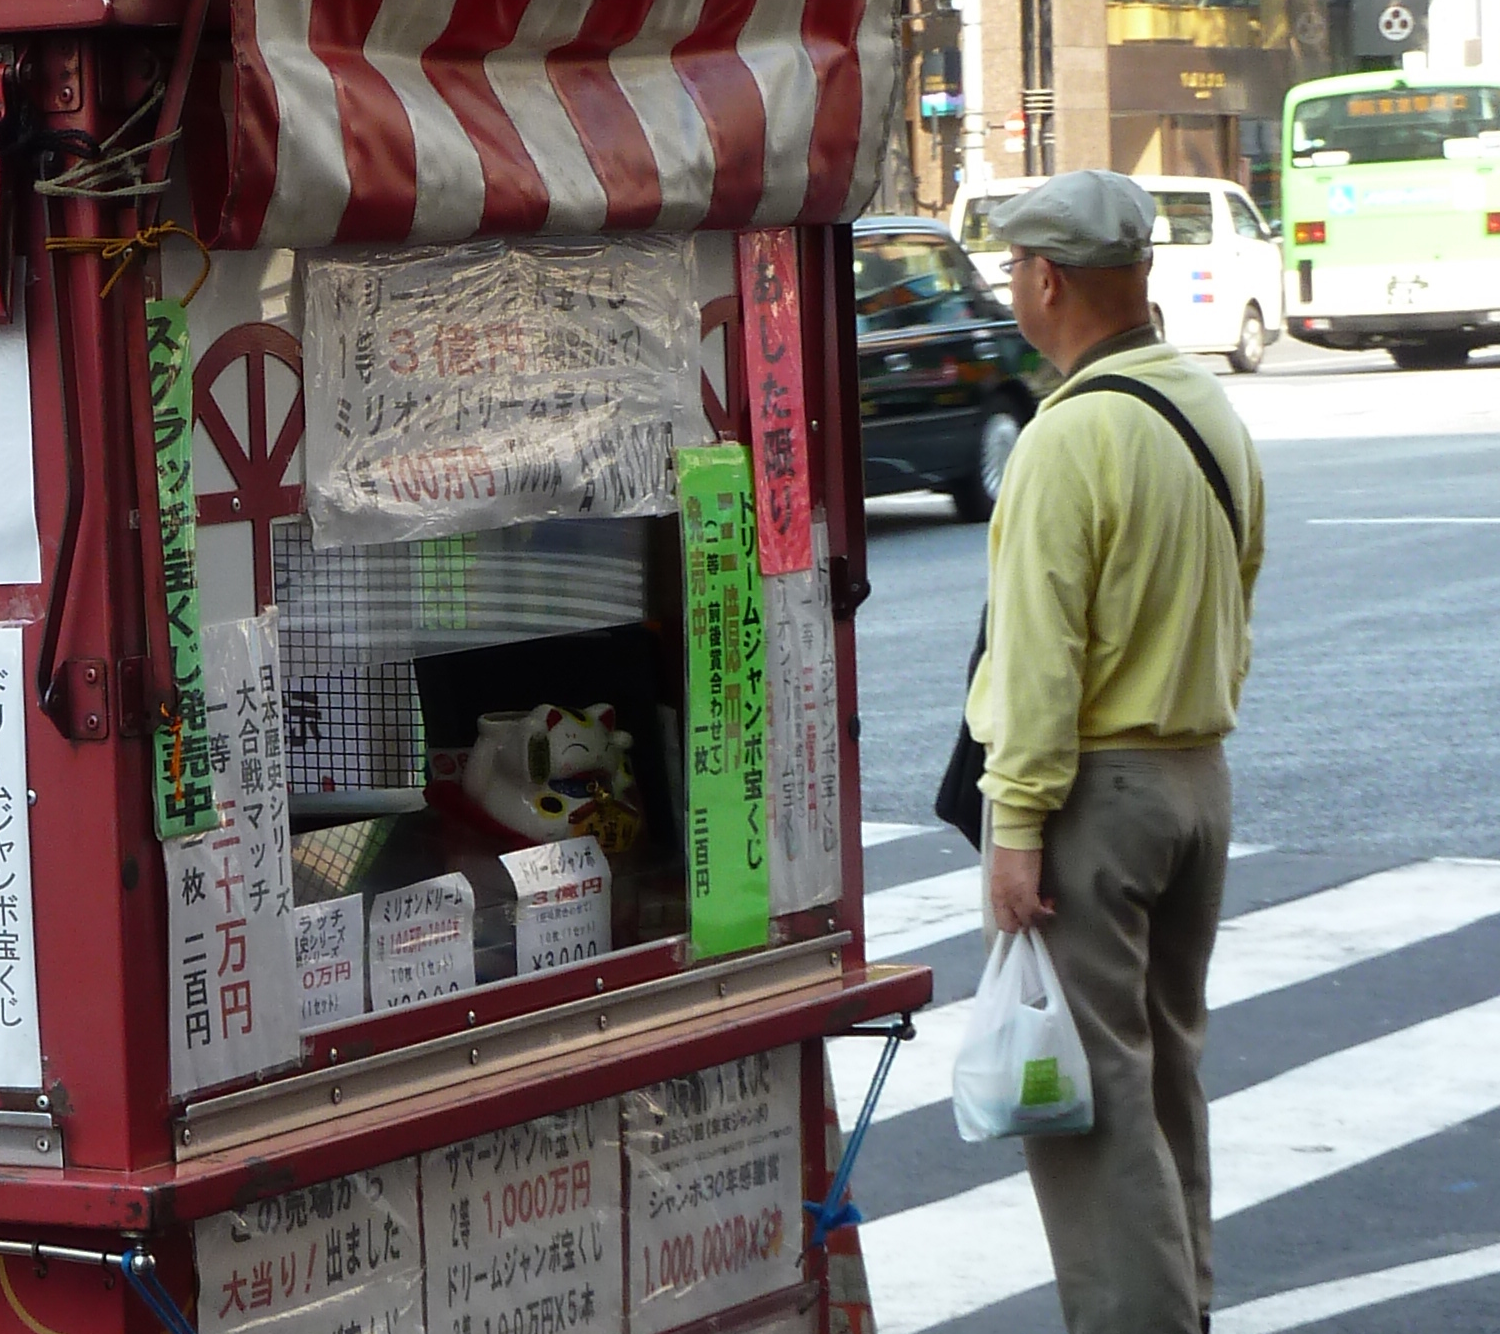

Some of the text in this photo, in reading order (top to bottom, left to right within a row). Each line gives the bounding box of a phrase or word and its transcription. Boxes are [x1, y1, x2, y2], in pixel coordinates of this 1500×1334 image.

[753, 264, 796, 535] あした限り
[739, 490, 765, 870] ドリームジャンボ宝くじ
[236, 678, 271, 914] 大合戦マッチ
[259, 663, 292, 918] 日本歴史シリーズ
[205, 701, 253, 1041] 一等 三十万円
[383, 885, 463, 924] ミリオンドリーム
[693, 808, 711, 899] 三百円
[299, 909, 343, 936] ラッチ
[182, 933, 212, 1050] 二百円
[302, 960, 352, 991] 0万円
[324, 1210, 402, 1287] 出ました
[482, 1159, 591, 1239] 1,000万円
